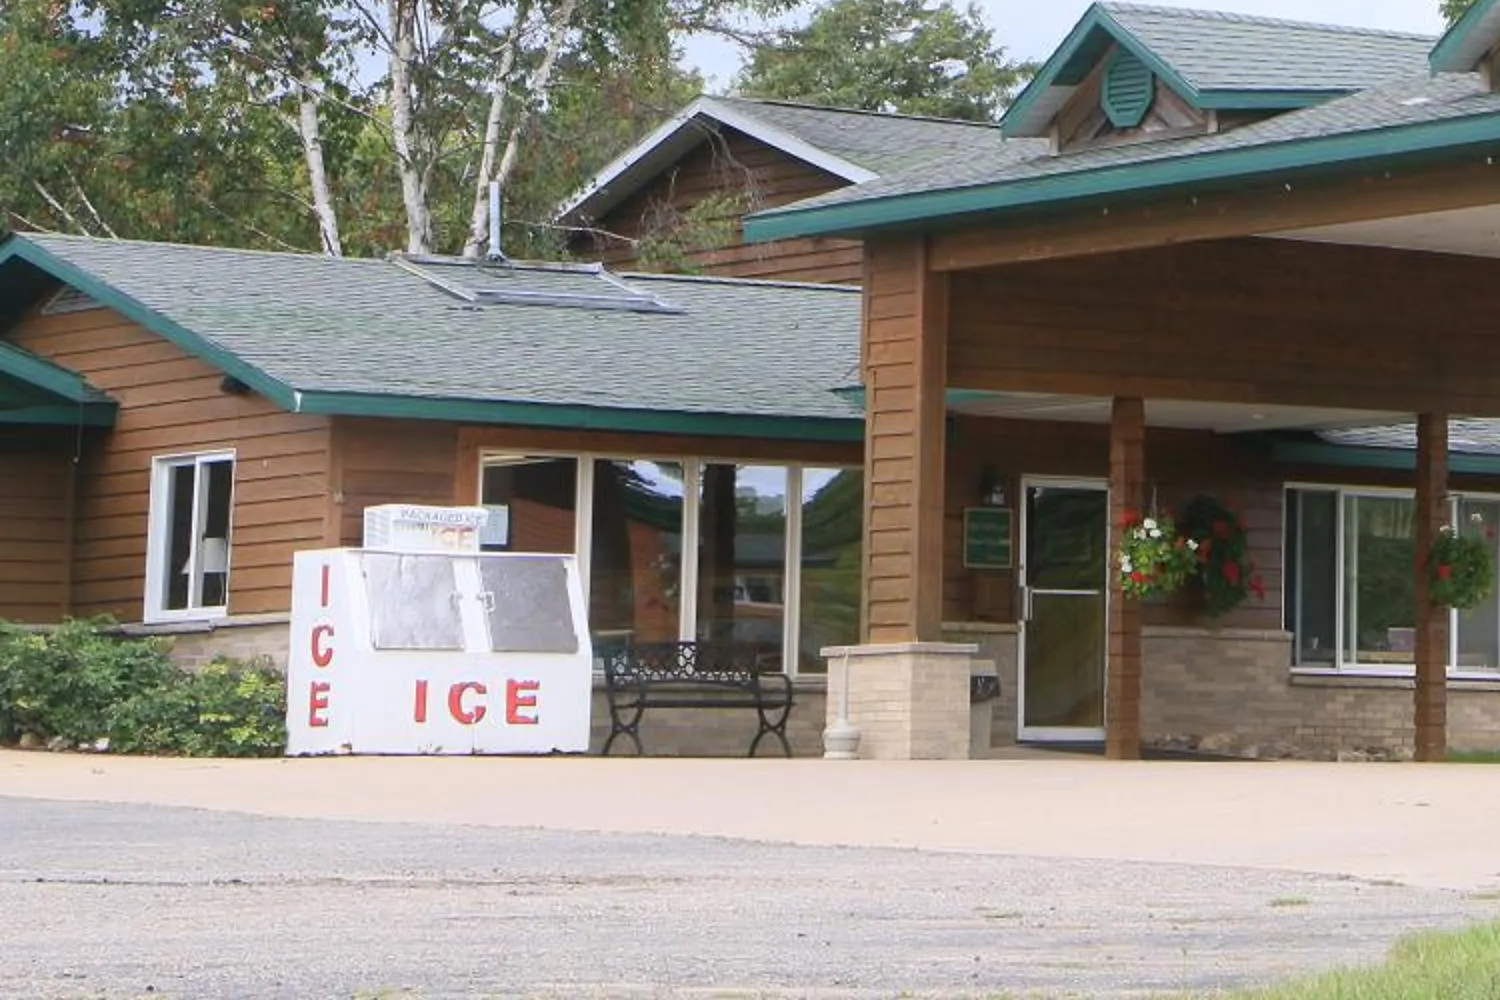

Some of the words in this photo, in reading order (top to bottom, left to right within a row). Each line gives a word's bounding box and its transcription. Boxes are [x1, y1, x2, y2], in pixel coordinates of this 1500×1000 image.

[400, 509, 462, 522] PACKAGED
[464, 511, 484, 525] ICE
[309, 564, 335, 727] ICE
[413, 678, 541, 725] ICE
